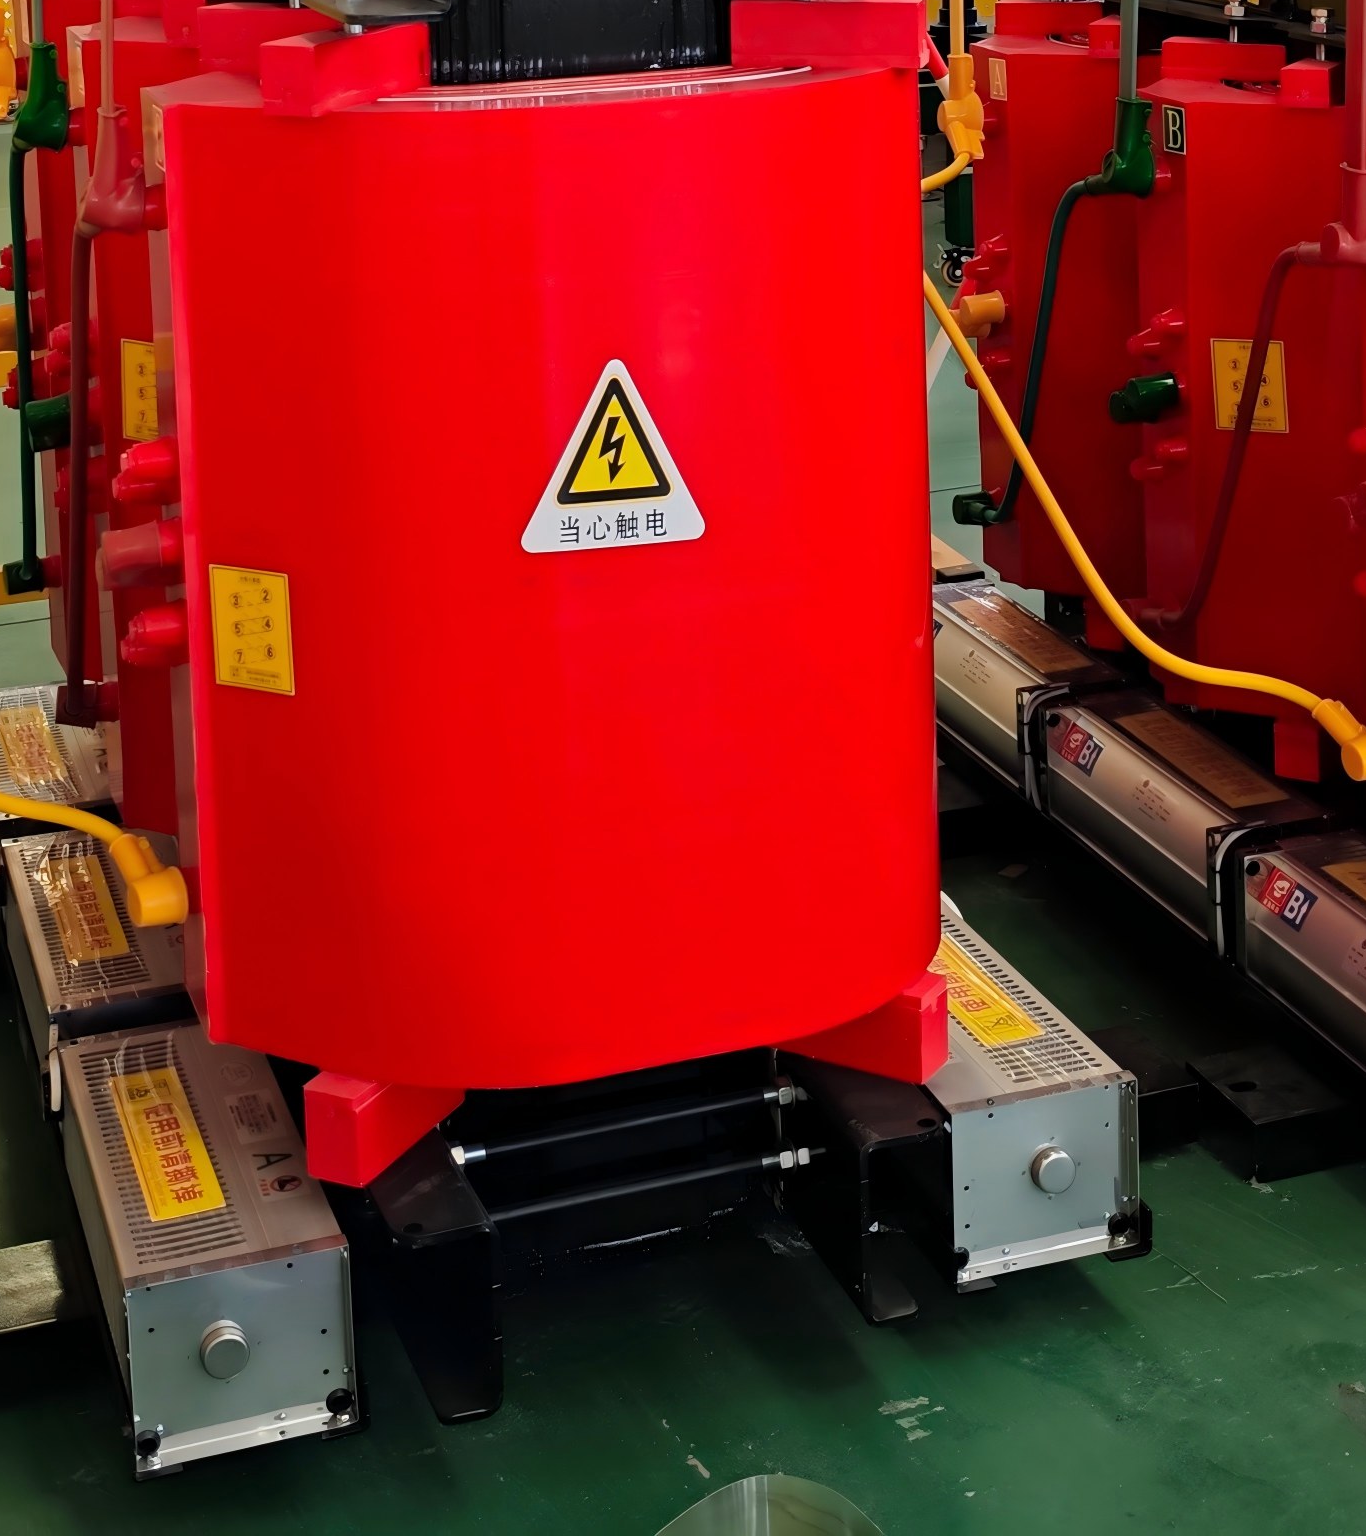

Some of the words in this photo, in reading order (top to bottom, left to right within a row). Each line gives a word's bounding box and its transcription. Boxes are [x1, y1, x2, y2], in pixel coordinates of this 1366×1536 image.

[993, 63, 1004, 96] A
[1167, 110, 1182, 149] B
[559, 508, 668, 544] 当心触电
[143, 1102, 204, 1203] 使用前请撕掉
[252, 1153, 293, 1171] A
